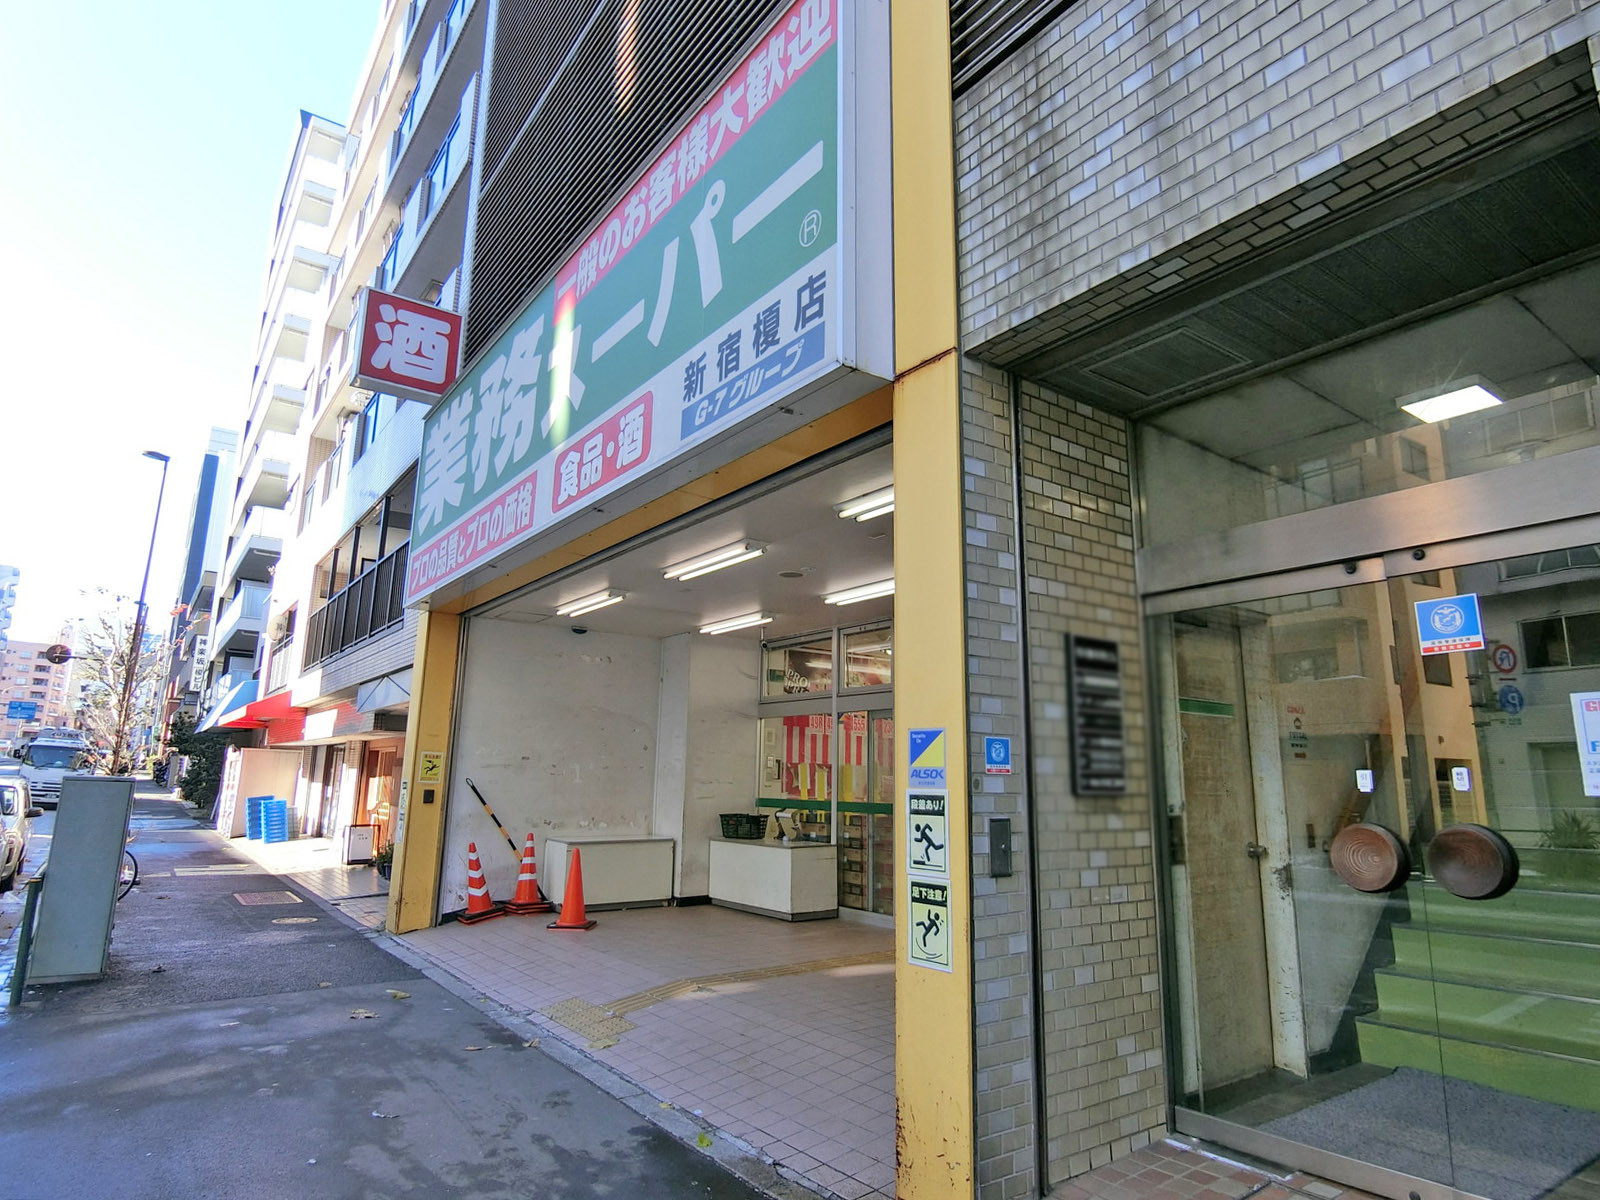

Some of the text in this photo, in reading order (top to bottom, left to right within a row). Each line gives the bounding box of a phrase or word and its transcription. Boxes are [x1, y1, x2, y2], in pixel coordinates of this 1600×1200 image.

[371, 303, 451, 385] 酒
[417, 140, 823, 536] 業務スーパー
[682, 270, 827, 403] 新宿榎店
[557, 402, 646, 506] 食品・酒
[410, 482, 534, 593] プロの品質とプロの価格
[910, 769, 944, 780] ALSOK
